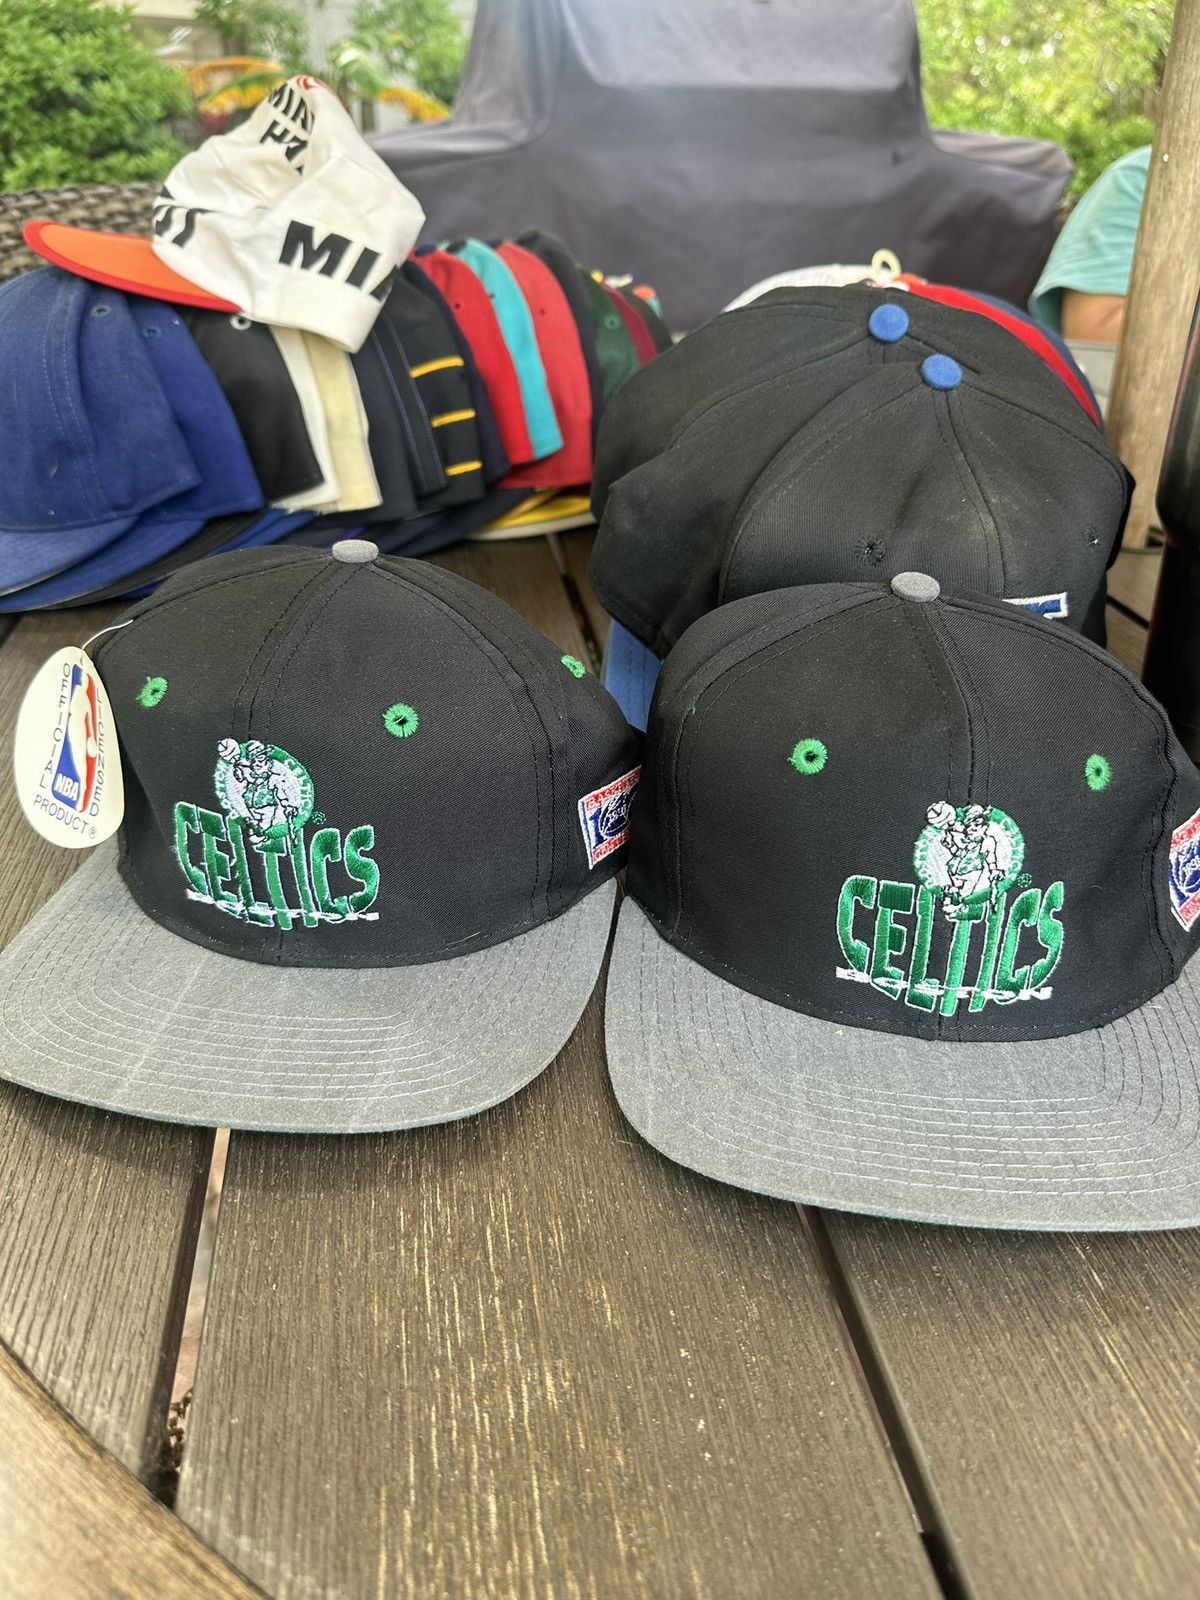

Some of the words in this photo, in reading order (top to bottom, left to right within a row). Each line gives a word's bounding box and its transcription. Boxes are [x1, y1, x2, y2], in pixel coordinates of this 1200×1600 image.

[39, 662, 71, 789] OFFICIAL
[53, 773, 80, 802] NBA
[174, 801, 380, 931] CELTICS
[837, 874, 1065, 1017] CELTICS
